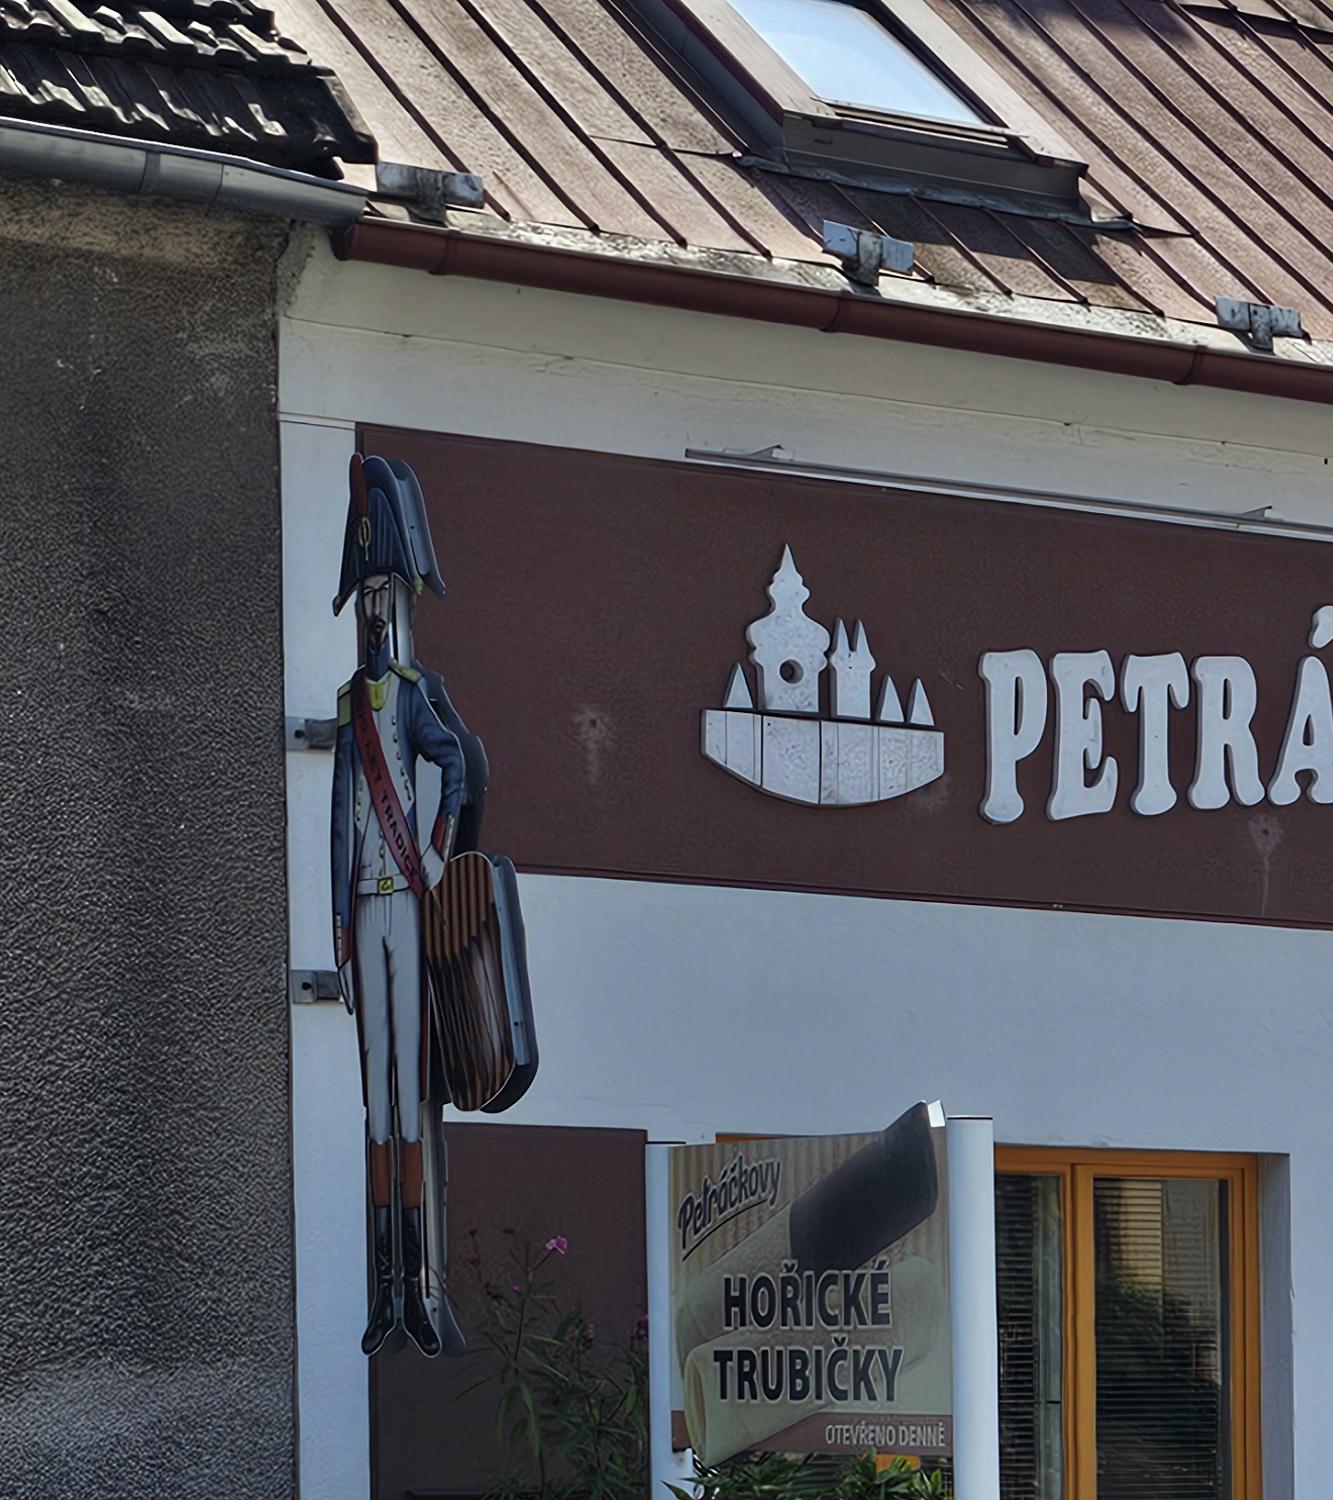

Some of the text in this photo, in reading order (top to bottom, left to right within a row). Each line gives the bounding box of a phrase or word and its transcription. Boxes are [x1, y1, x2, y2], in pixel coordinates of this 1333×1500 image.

[678, 1155, 782, 1250] Petráčkovy
[723, 1260, 892, 1328] HOŘICKÉ
[713, 1337, 903, 1402] TRUBIČKY
[825, 1420, 946, 1447] OTEVŘENO DENNĚ
